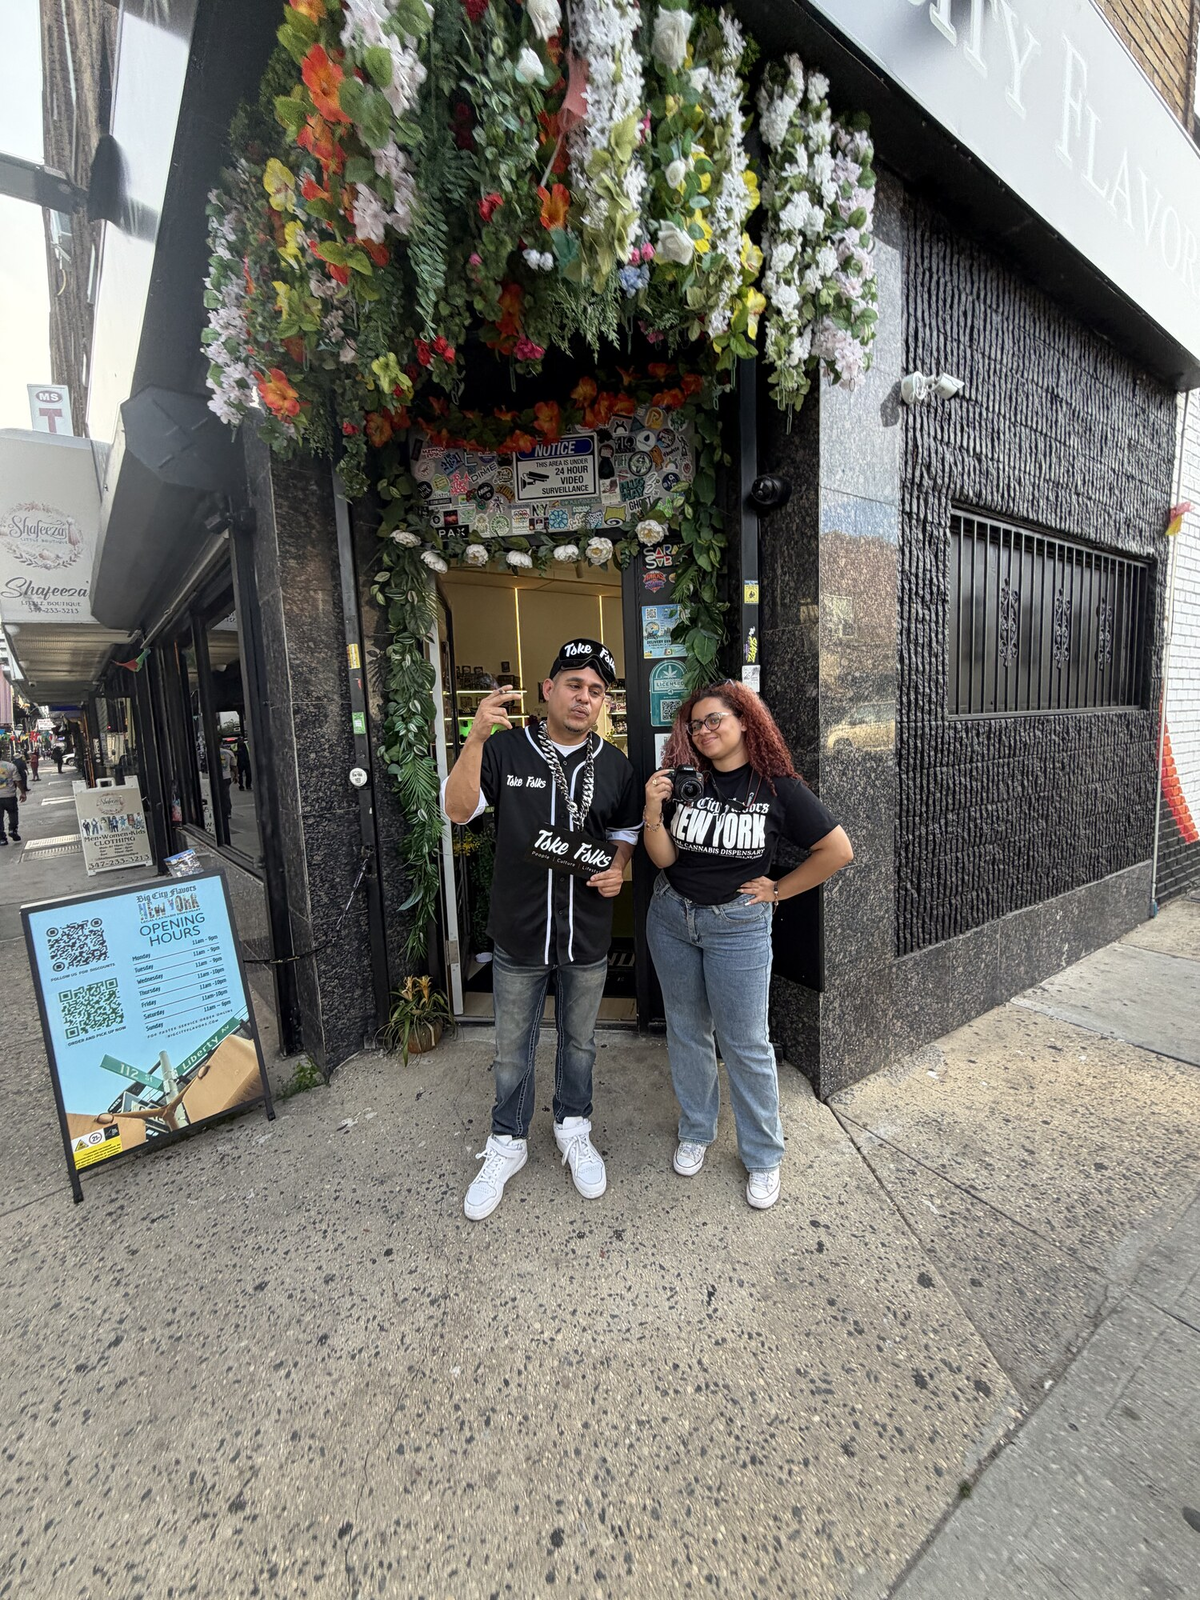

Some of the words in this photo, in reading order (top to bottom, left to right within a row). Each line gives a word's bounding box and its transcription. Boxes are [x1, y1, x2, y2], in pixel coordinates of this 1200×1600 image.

[39, 392, 59, 402] MS
[534, 441, 576, 457] NOTICE
[555, 467, 565, 476] 24
[566, 465, 588, 475] HOUR
[560, 476, 584, 485] VIDEO
[542, 485, 589, 495] SURVEILLANCE
[628, 496, 652, 511] GHT
[438, 528, 465, 538] PAX
[600, 647, 616, 675] Fol
[712, 812, 766, 849] YORK
[94, 836, 136, 846] CLOTHING
[684, 842, 719, 854] CANNABIS
[531, 850, 550, 860] People
[556, 858, 576, 867] Culture
[136, 895, 150, 903] Big
[152, 892, 168, 901] City
[170, 885, 196, 896] Flavors
[140, 912, 205, 936] OPENING
[149, 925, 200, 947] HOURS
[132, 953, 151, 962] Monday
[90, 963, 115, 972] DISCOUNTS
[135, 964, 154, 973] Tuesday
[137, 974, 163, 984] Wednesday
[139, 986, 160, 996] Thursday
[143, 1010, 164, 1020] Saturday
[146, 1022, 163, 1032] Sunday
[68, 1038, 85, 1046] ORDER
[182, 1036, 219, 1070] Liberty
[120, 1063, 139, 1080] 112
